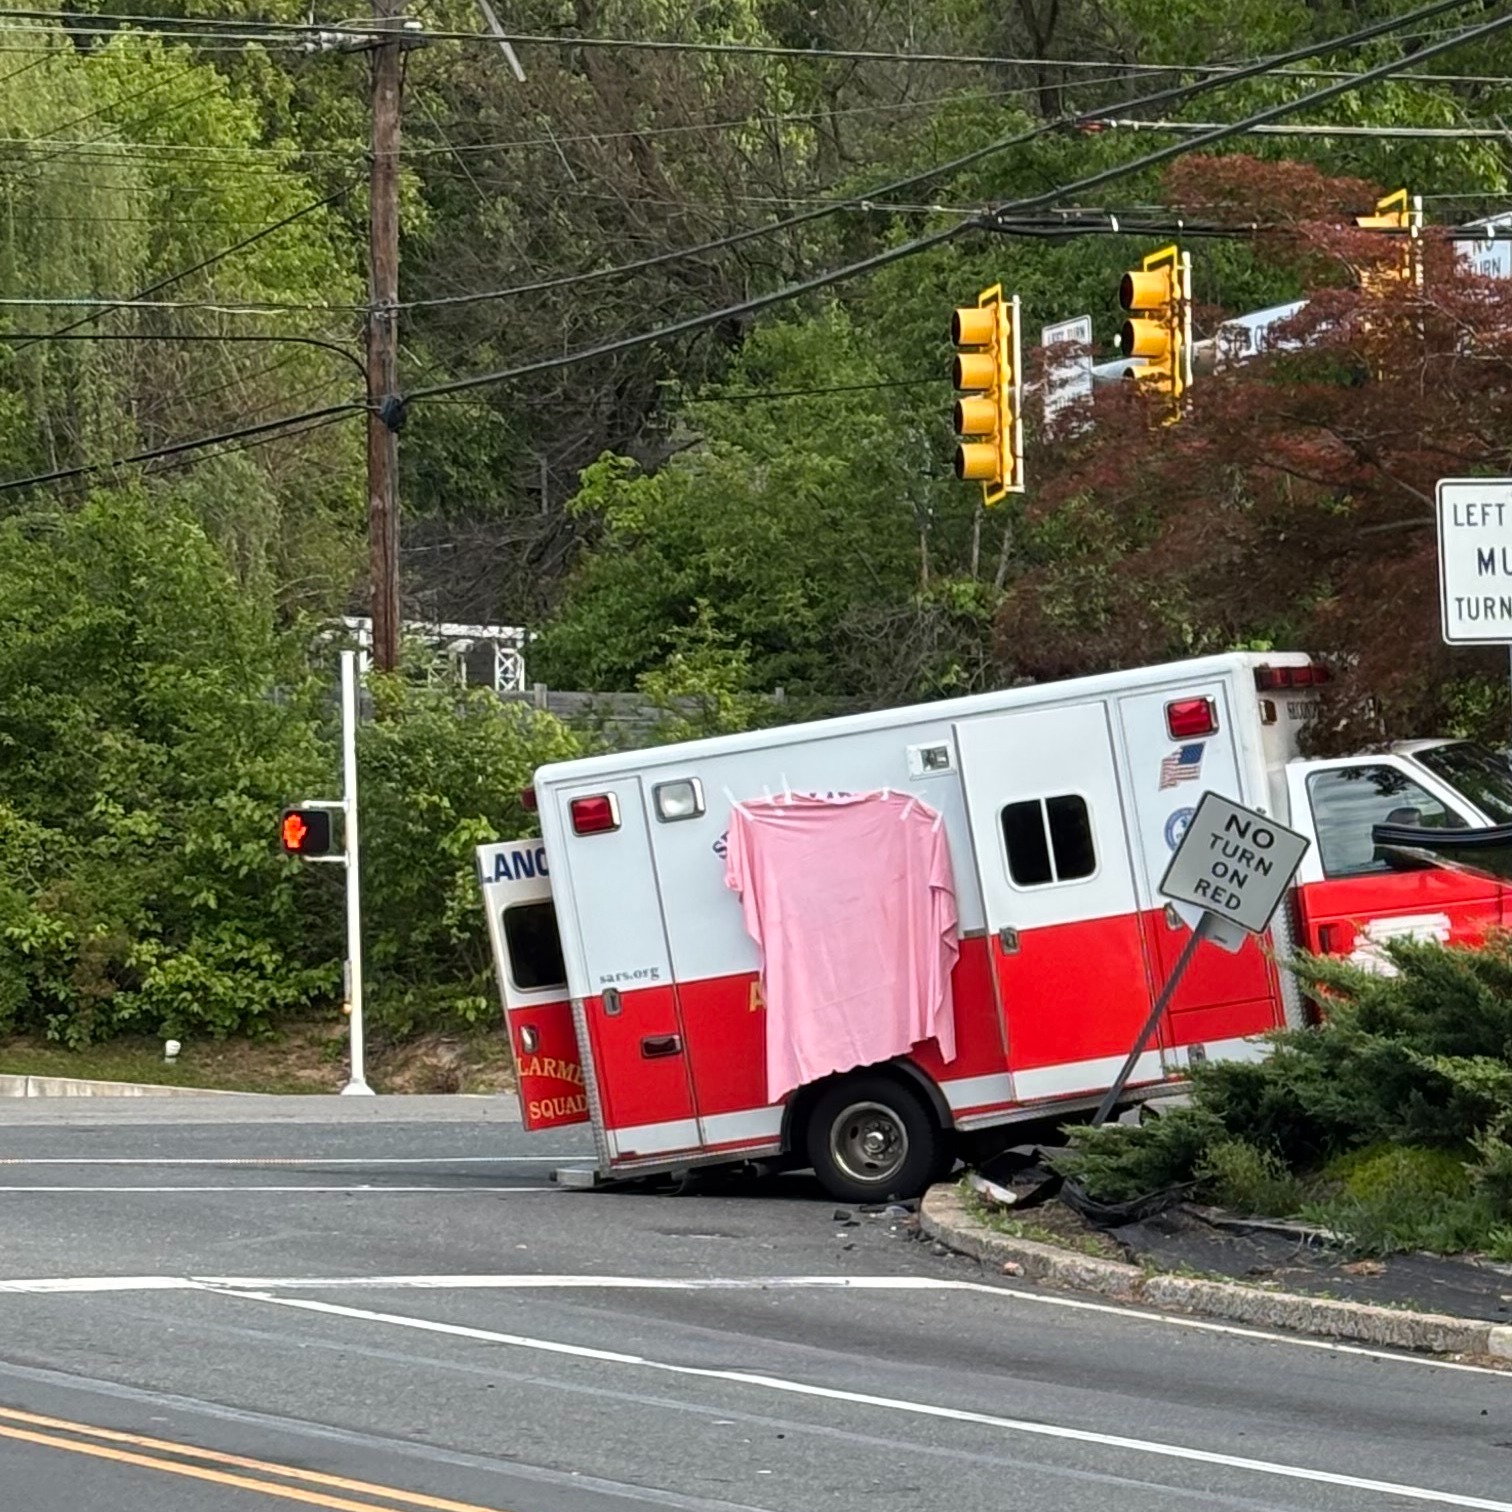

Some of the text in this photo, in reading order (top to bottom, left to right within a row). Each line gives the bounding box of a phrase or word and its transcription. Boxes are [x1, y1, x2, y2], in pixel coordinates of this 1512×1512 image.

[1453, 503, 1505, 527] LEFT
[1454, 596, 1512, 621] TURN
[1224, 813, 1274, 849] NO
[1209, 832, 1273, 877] TURN
[1211, 861, 1248, 889] ON
[1193, 878, 1242, 911] RED
[600, 966, 660, 984] sars.org
[529, 1094, 589, 1119] SQUAD
